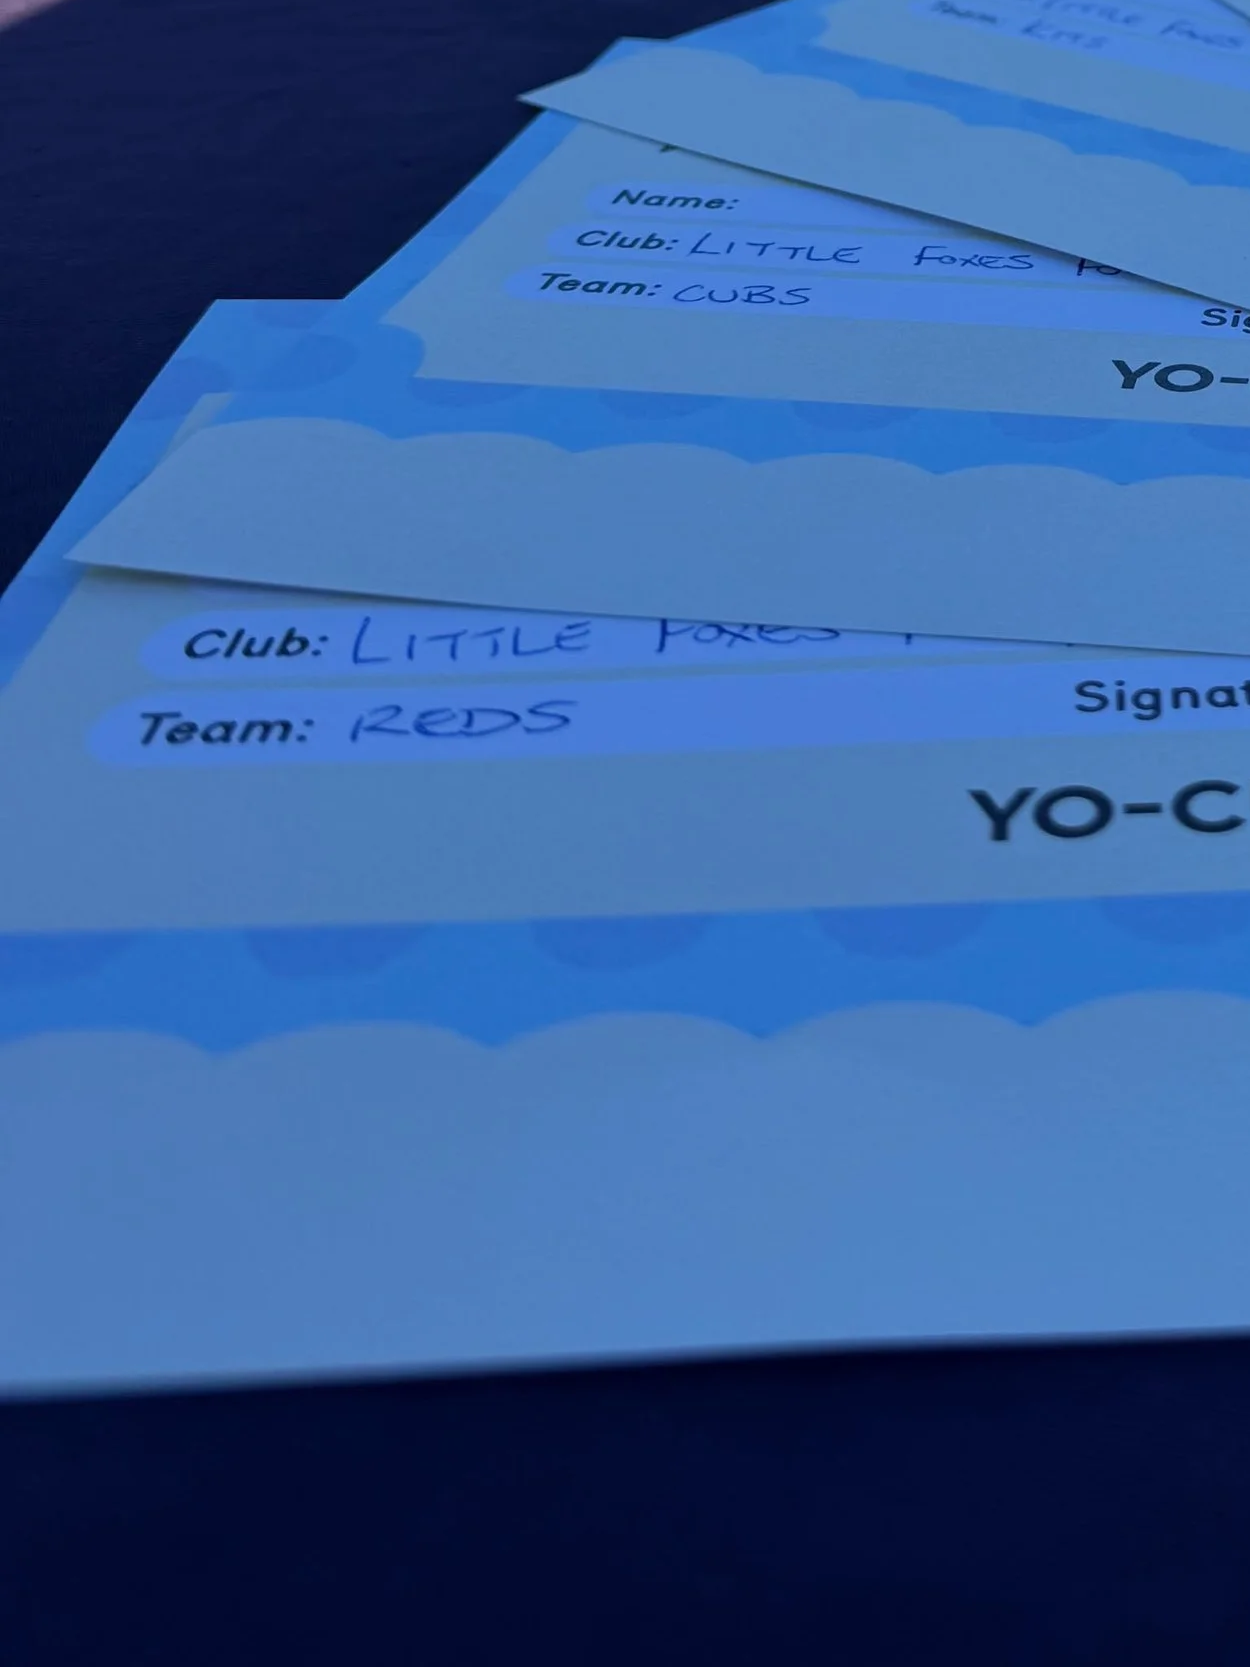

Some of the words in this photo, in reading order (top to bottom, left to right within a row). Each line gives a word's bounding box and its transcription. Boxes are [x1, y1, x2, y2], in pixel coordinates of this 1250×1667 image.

[611, 188, 741, 211] Name:
[575, 229, 680, 252] Club:
[685, 231, 864, 264] LITTLE
[538, 271, 664, 297] Team:
[671, 284, 814, 306] CUBS
[183, 625, 330, 661] Club:
[350, 614, 593, 667] LITTLE
[138, 708, 317, 748] Team:
